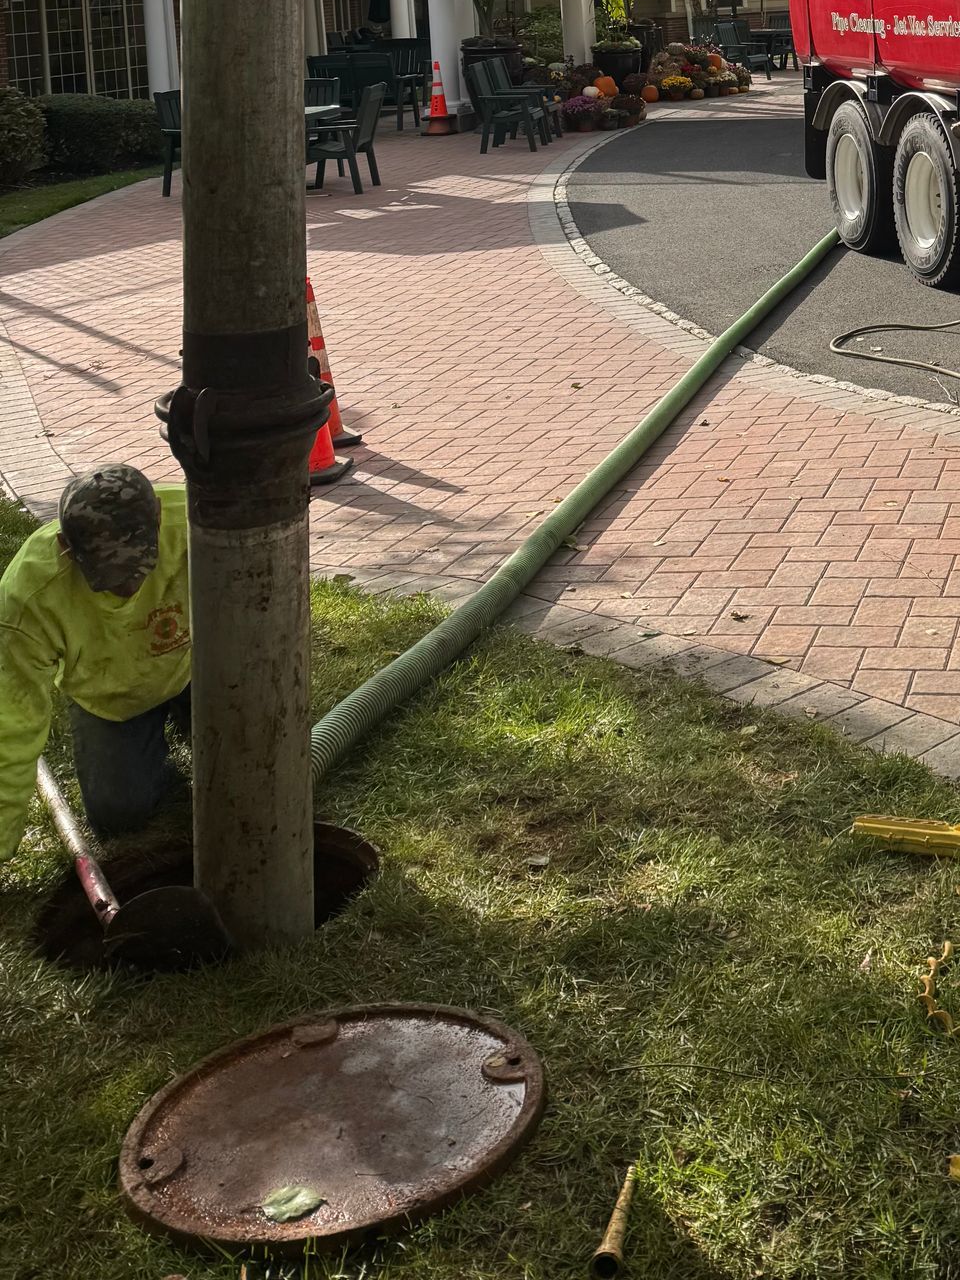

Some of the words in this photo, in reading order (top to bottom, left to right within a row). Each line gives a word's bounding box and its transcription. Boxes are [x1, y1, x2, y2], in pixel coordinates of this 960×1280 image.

[831, 12, 849, 35] Pipe
[849, 12, 886, 39] Cleaning
[893, 15, 908, 36] Jet
[908, 15, 927, 36] Vac
